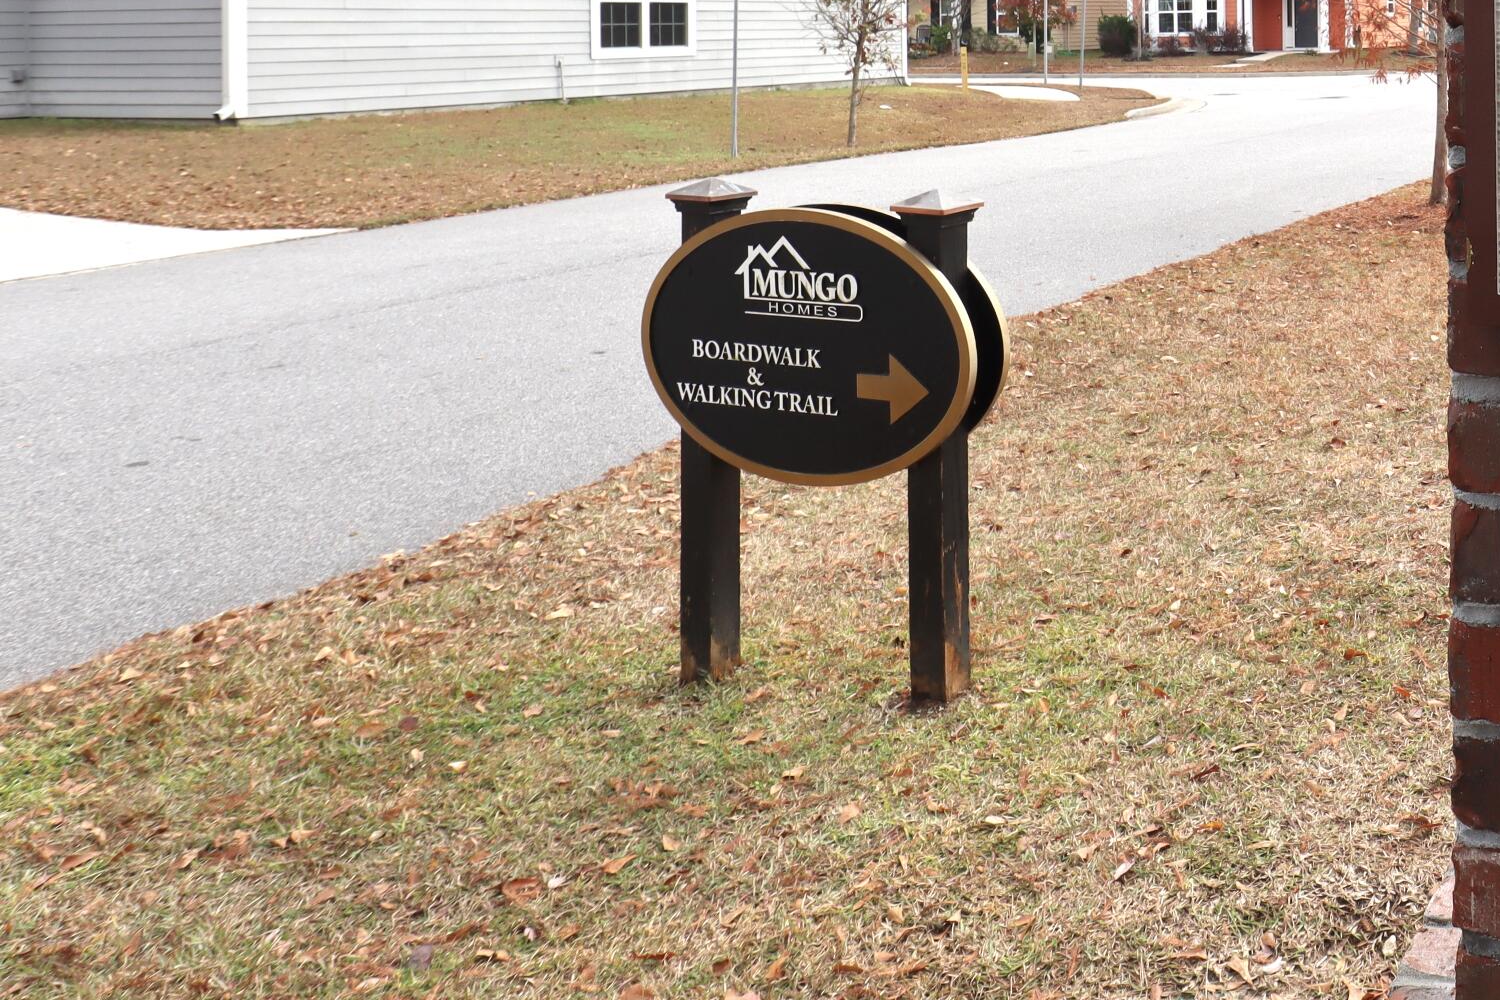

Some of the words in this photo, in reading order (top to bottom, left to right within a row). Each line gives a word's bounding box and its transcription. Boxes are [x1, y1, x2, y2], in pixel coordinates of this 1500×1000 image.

[752, 267, 858, 303] MUNGO
[768, 301, 838, 318] HOMES
[692, 338, 821, 369] BOARDWALK
[747, 367, 765, 386] &
[677, 382, 772, 410] WALKING
[772, 389, 838, 416] TRAIL
